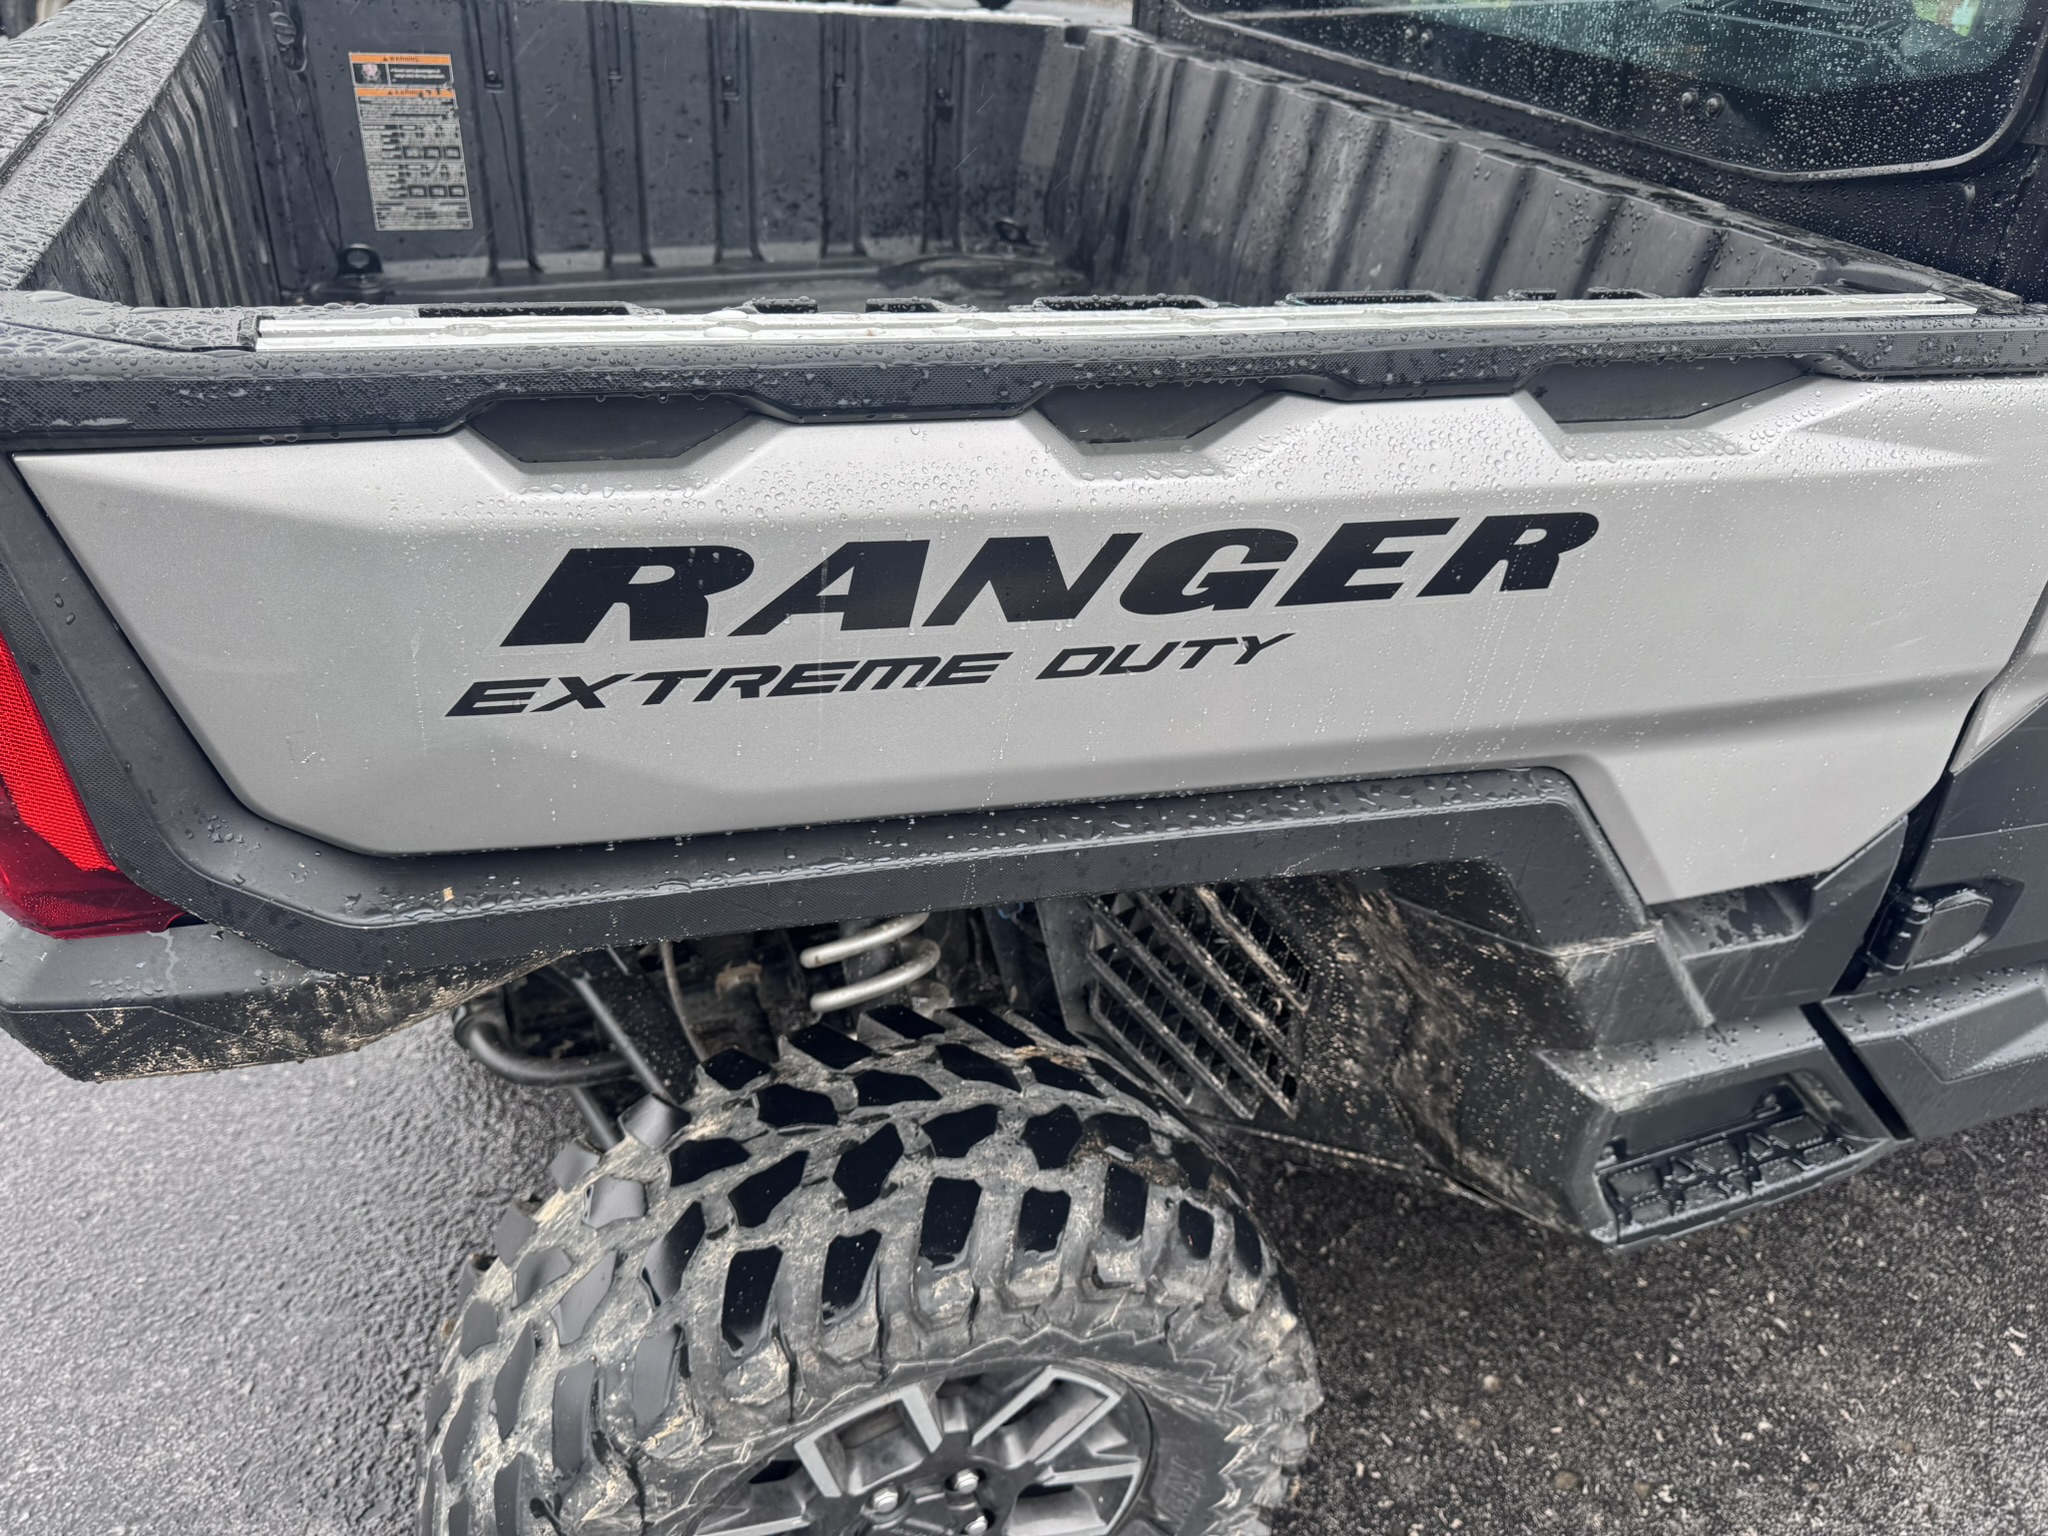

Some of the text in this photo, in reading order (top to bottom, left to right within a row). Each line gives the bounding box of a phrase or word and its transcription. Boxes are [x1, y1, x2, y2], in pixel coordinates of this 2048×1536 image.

[501, 511, 1600, 646] RANGER
[446, 633, 1294, 716] EXTREME DUTY
